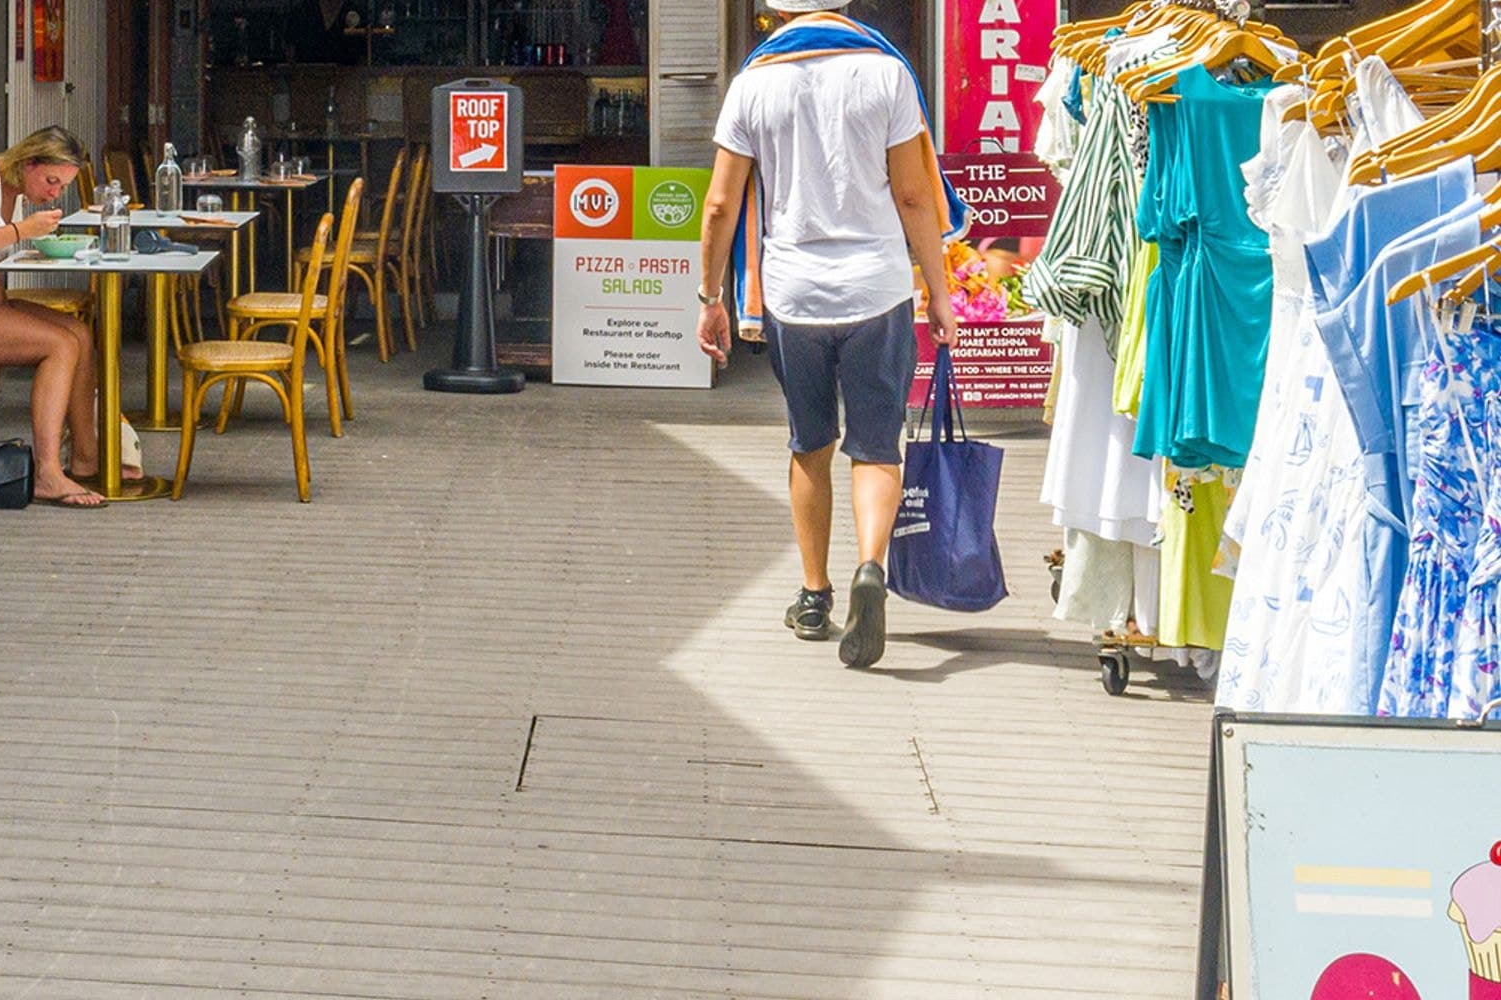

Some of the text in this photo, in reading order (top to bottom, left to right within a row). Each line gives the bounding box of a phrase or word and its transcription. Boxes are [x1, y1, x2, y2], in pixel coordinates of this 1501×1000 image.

[457, 98, 501, 118] ROOF
[467, 119, 501, 139] TOP
[965, 165, 1006, 182] THE
[957, 185, 1047, 203] RDAMON
[573, 193, 616, 212] MVP
[970, 208, 1010, 226] POD
[576, 257, 690, 275] PIZZA PASTA
[602, 278, 663, 296] SALADS
[606, 318, 660, 328] Explore our
[583, 328, 683, 340] Restaurant or Rooftop
[974, 328, 999, 337] BAY'S
[1001, 327, 1042, 337] ORIGINA
[960, 338, 1028, 347] HARE KRISHNA
[603, 350, 661, 359] Please order
[948, 347, 1040, 358] VEGETARIAN EATERY
[613, 361, 628, 369] the
[630, 362, 681, 371] Restaurant
[984, 366, 1012, 374] WHERE
[1013, 365, 1028, 374] THE
